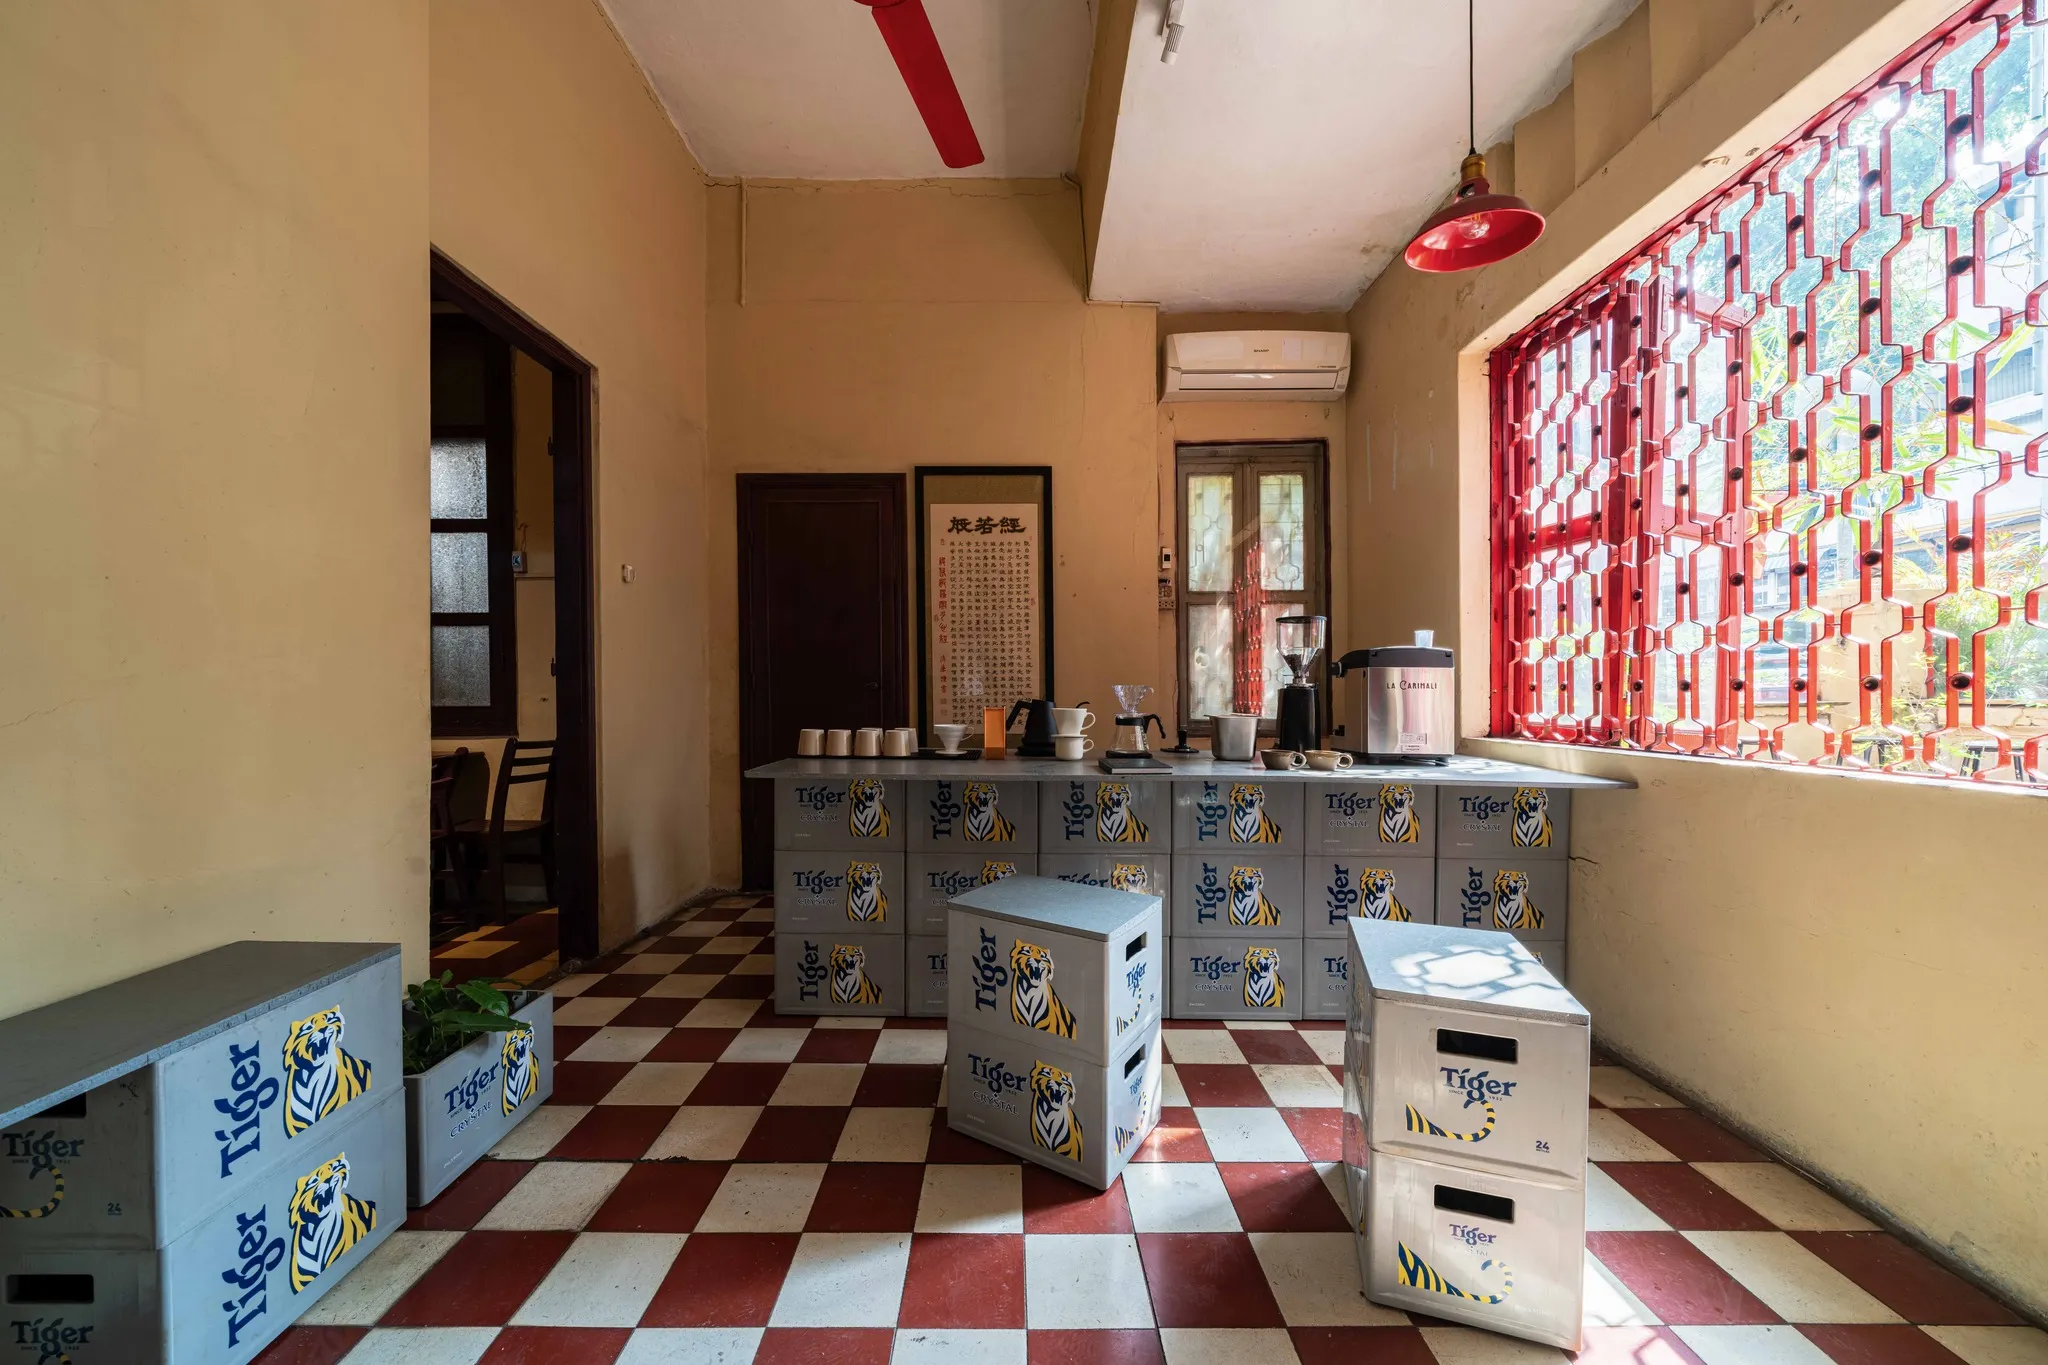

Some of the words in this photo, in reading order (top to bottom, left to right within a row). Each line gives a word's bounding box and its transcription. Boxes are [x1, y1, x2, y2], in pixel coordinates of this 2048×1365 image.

[1386, 682, 1396, 690] LA
[1399, 680, 1438, 691] CARIMALI
[795, 785, 846, 811] Tiger
[930, 780, 962, 840] Tiger
[1062, 780, 1095, 841] Tiger
[1196, 780, 1228, 842] Tiger
[1325, 791, 1377, 817] Tiger
[1459, 795, 1510, 821] Tiger
[792, 869, 844, 895] Tiger
[927, 870, 979, 896] Tiger
[1195, 862, 1227, 925] Tiger
[1326, 863, 1358, 926] Tiger
[1460, 866, 1492, 928] Tiger
[796, 940, 829, 1002] Tiger
[971, 926, 1009, 1013] Tiger
[1125, 962, 1148, 989] Tiger
[1189, 955, 1242, 981] Tiger
[443, 1061, 500, 1115] Tiger
[967, 1053, 1027, 1094] Tiger
[1439, 1066, 1518, 1102] Tiger
[213, 1039, 281, 1179] Tiger
[449, 1100, 494, 1139] CRYSTAL
[973, 1090, 1021, 1117] CRYSTAL
[0, 1130, 86, 1169] Tiger
[1535, 1140, 1550, 1151] 24
[1448, 1223, 1498, 1246] Tiger
[221, 1203, 286, 1349] Tiger
[9, 1317, 95, 1356] Tiger
